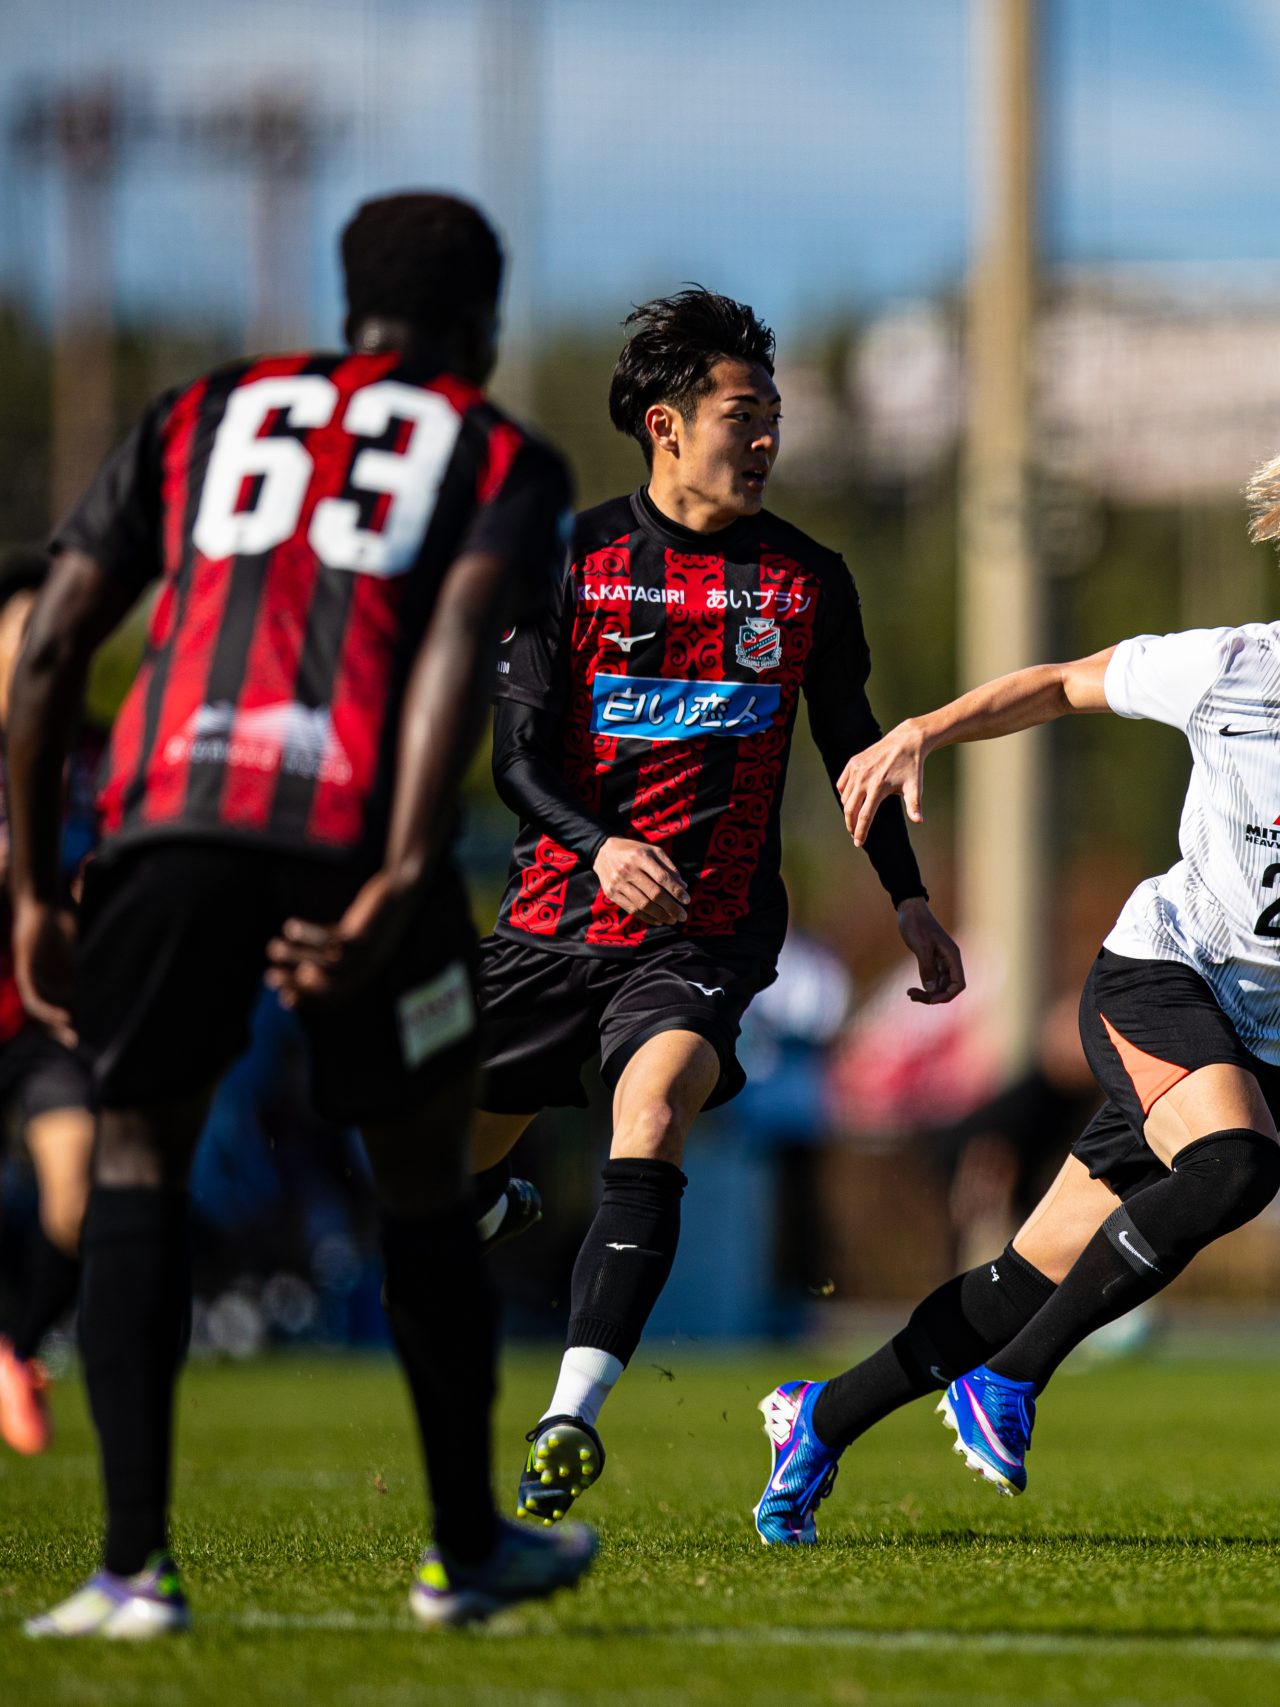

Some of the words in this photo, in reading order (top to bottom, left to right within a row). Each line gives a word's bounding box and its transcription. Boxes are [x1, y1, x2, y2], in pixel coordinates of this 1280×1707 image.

[192, 373, 462, 580] 63
[600, 584, 685, 605] KATAGIRI
[706, 587, 811, 613] あいプラン
[603, 687, 758, 728] 白い恋人
